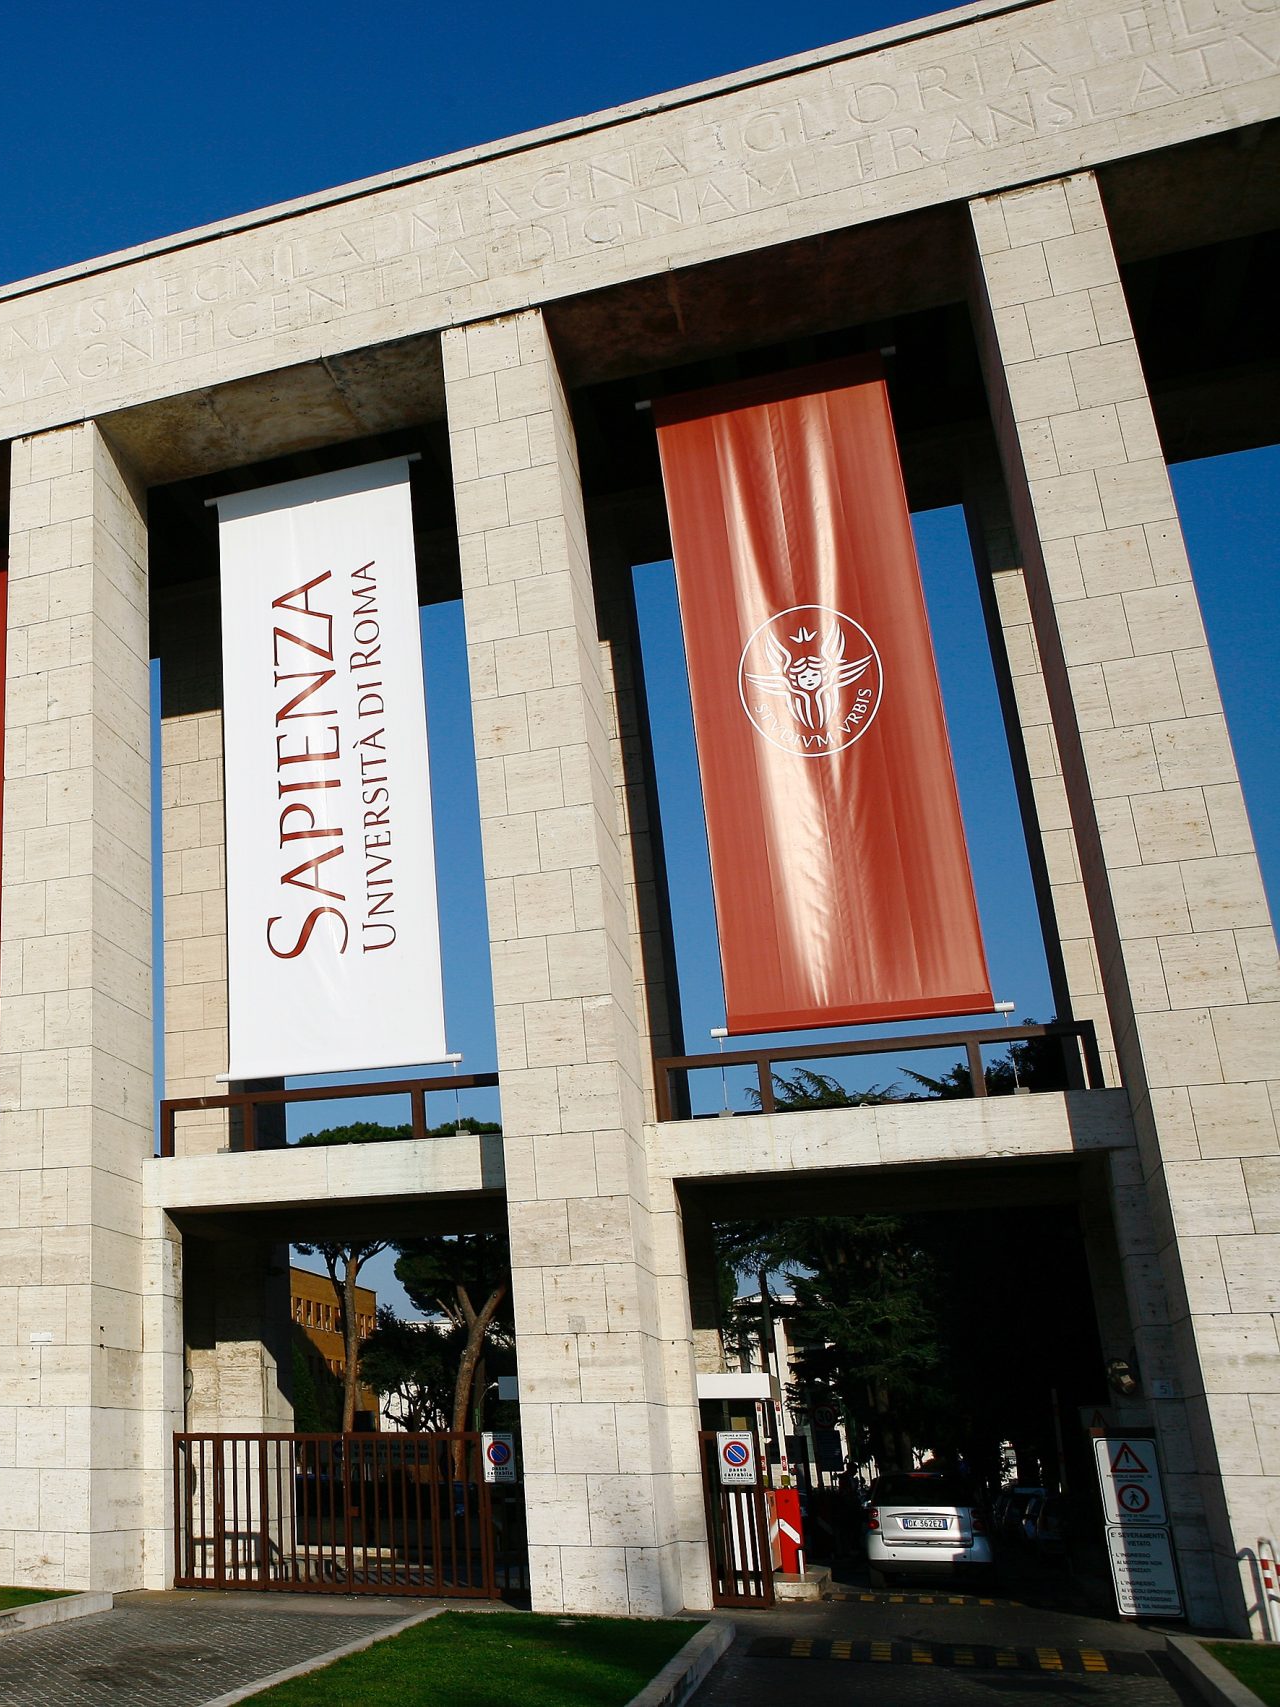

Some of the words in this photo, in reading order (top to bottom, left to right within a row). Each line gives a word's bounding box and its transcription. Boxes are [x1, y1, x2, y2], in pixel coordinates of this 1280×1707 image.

[89, 229, 365, 339] SAECVLA
[408, 139, 690, 250] MAGNA
[741, 37, 1059, 160] GLORIA
[1120, 0, 1280, 53] FL
[515, 151, 803, 269] DIGNAM
[350, 560, 383, 673] ROMA
[356, 681, 385, 719] DI
[754, 703, 834, 748] STVDIVM
[838, 688, 872, 734] VRBIS
[266, 569, 349, 959] SAPIENZA
[352, 727, 397, 954] UNIVERSITÀ
